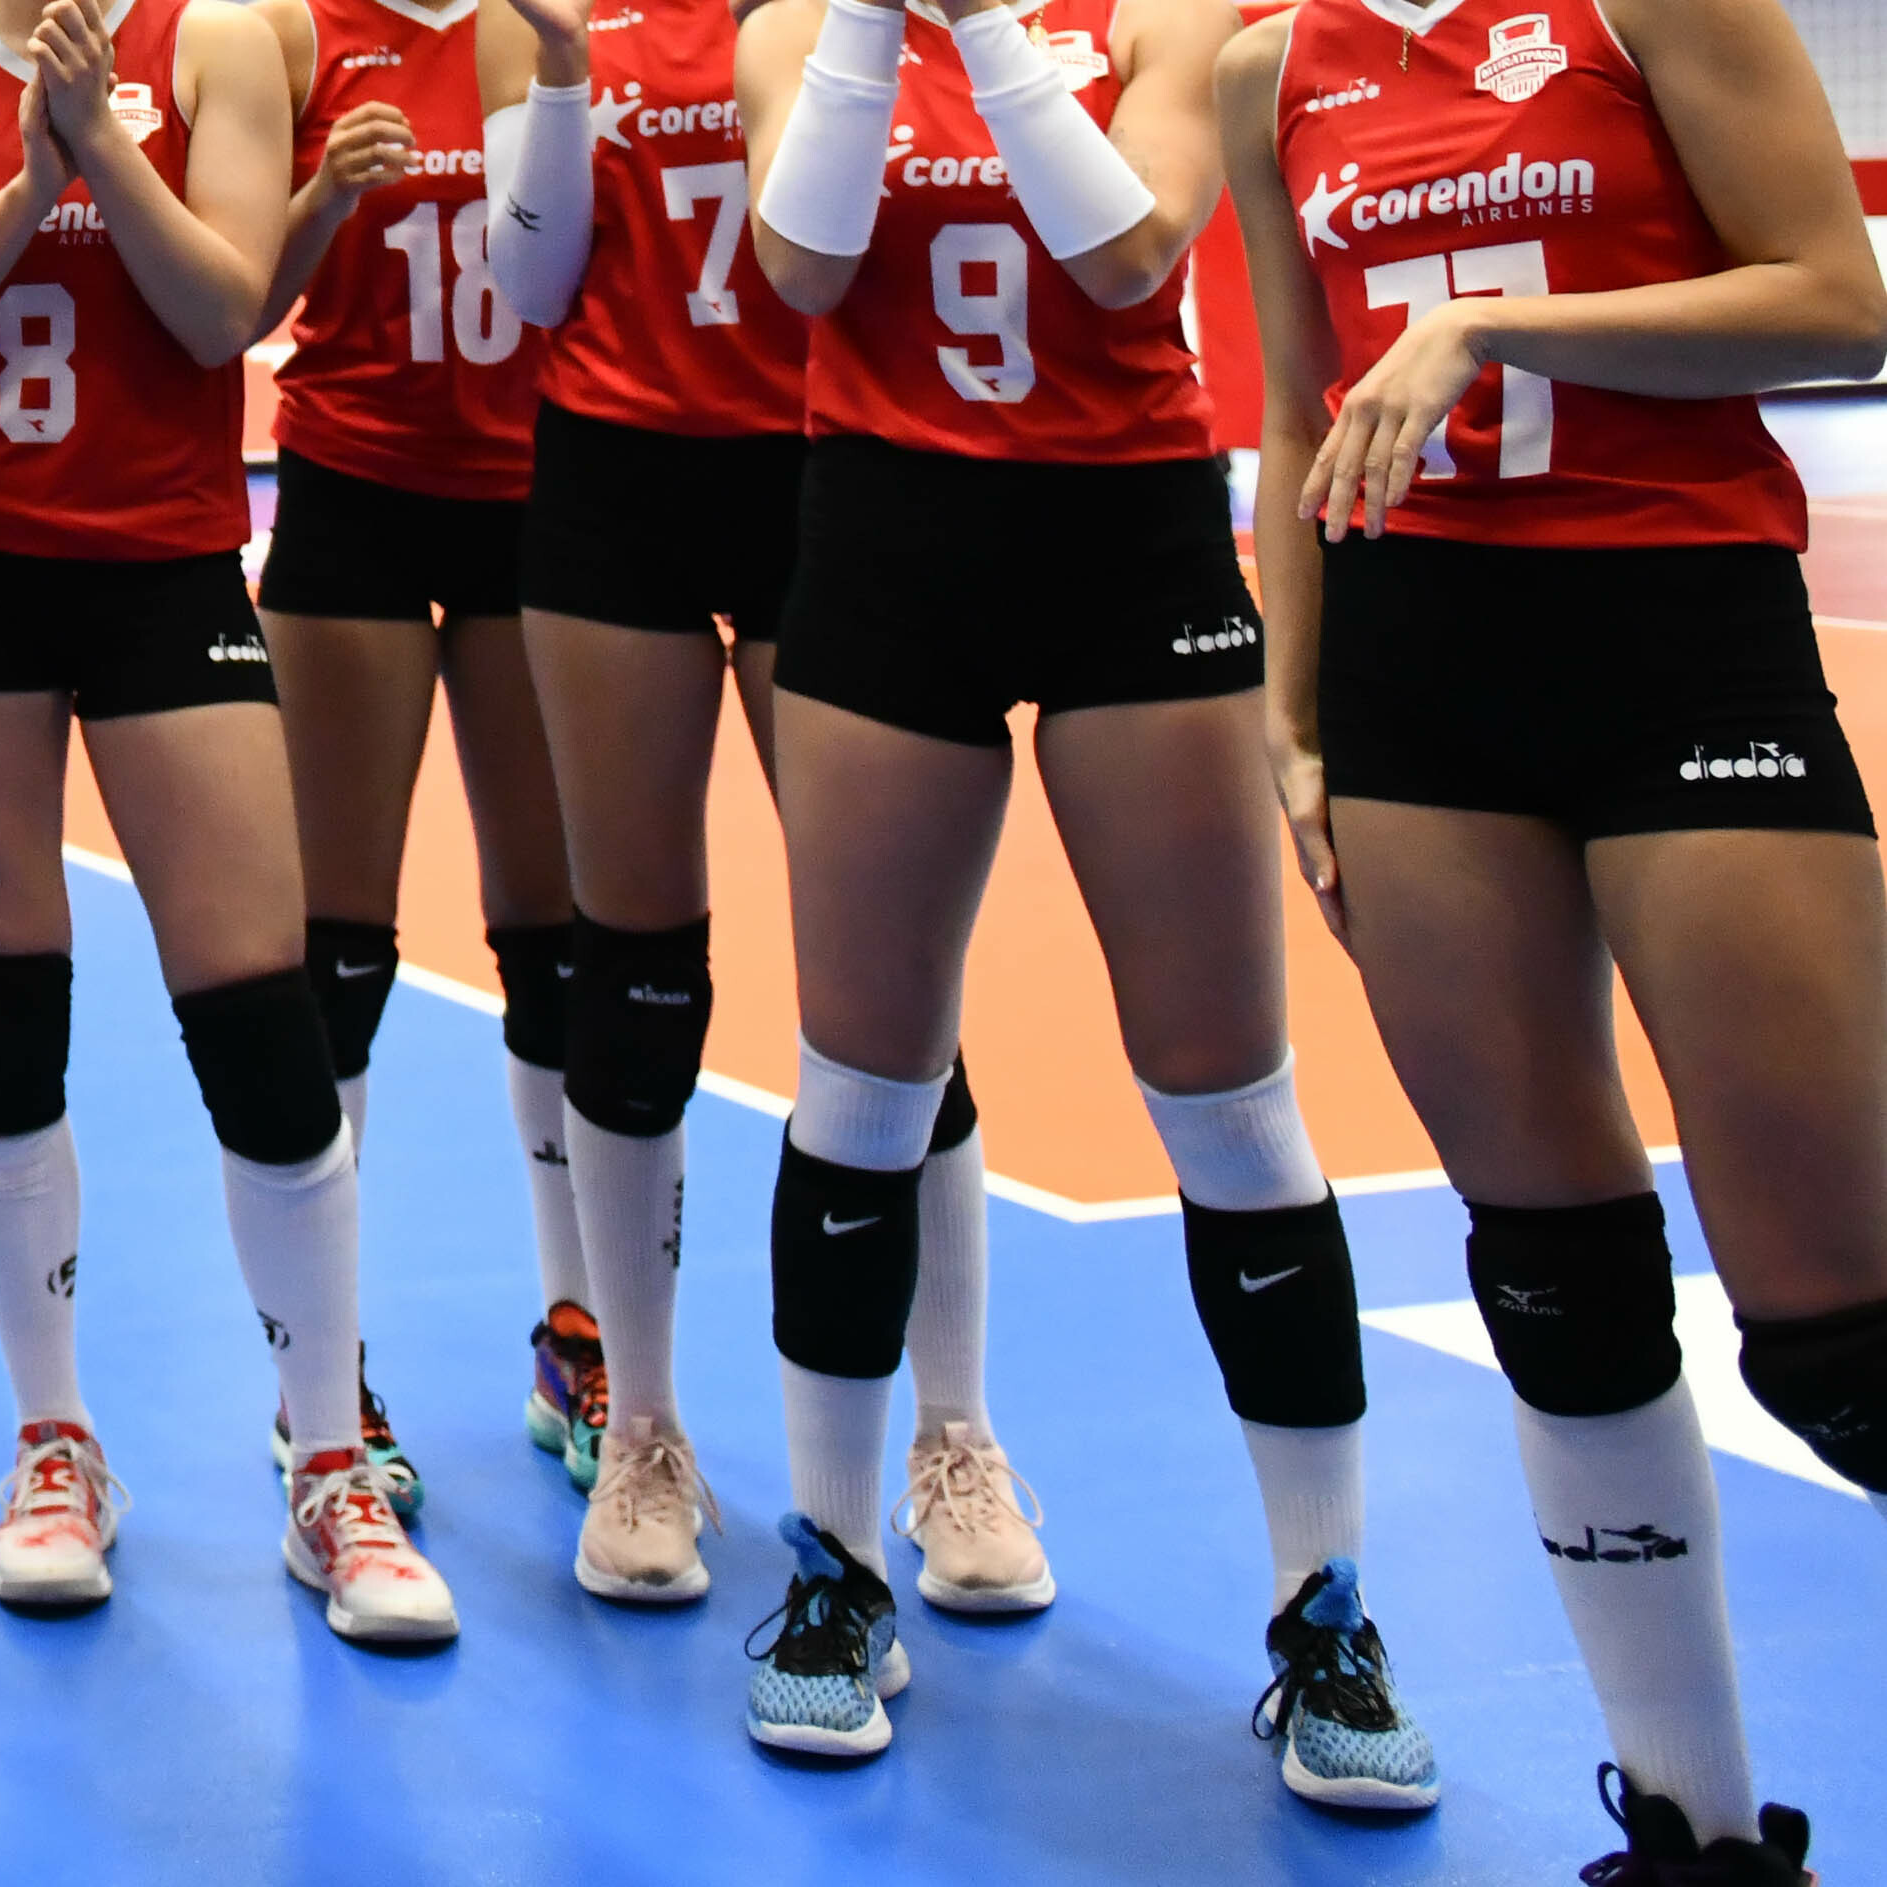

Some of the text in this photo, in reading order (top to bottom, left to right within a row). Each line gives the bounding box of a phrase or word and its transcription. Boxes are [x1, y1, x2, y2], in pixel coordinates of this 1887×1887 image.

[661, 160, 749, 327] 7
[1351, 152, 1595, 231] corendon
[1461, 198, 1594, 227] AIRLINES
[383, 200, 523, 365] 18
[930, 223, 1036, 404] 9
[1679, 741, 1807, 780] diadora
